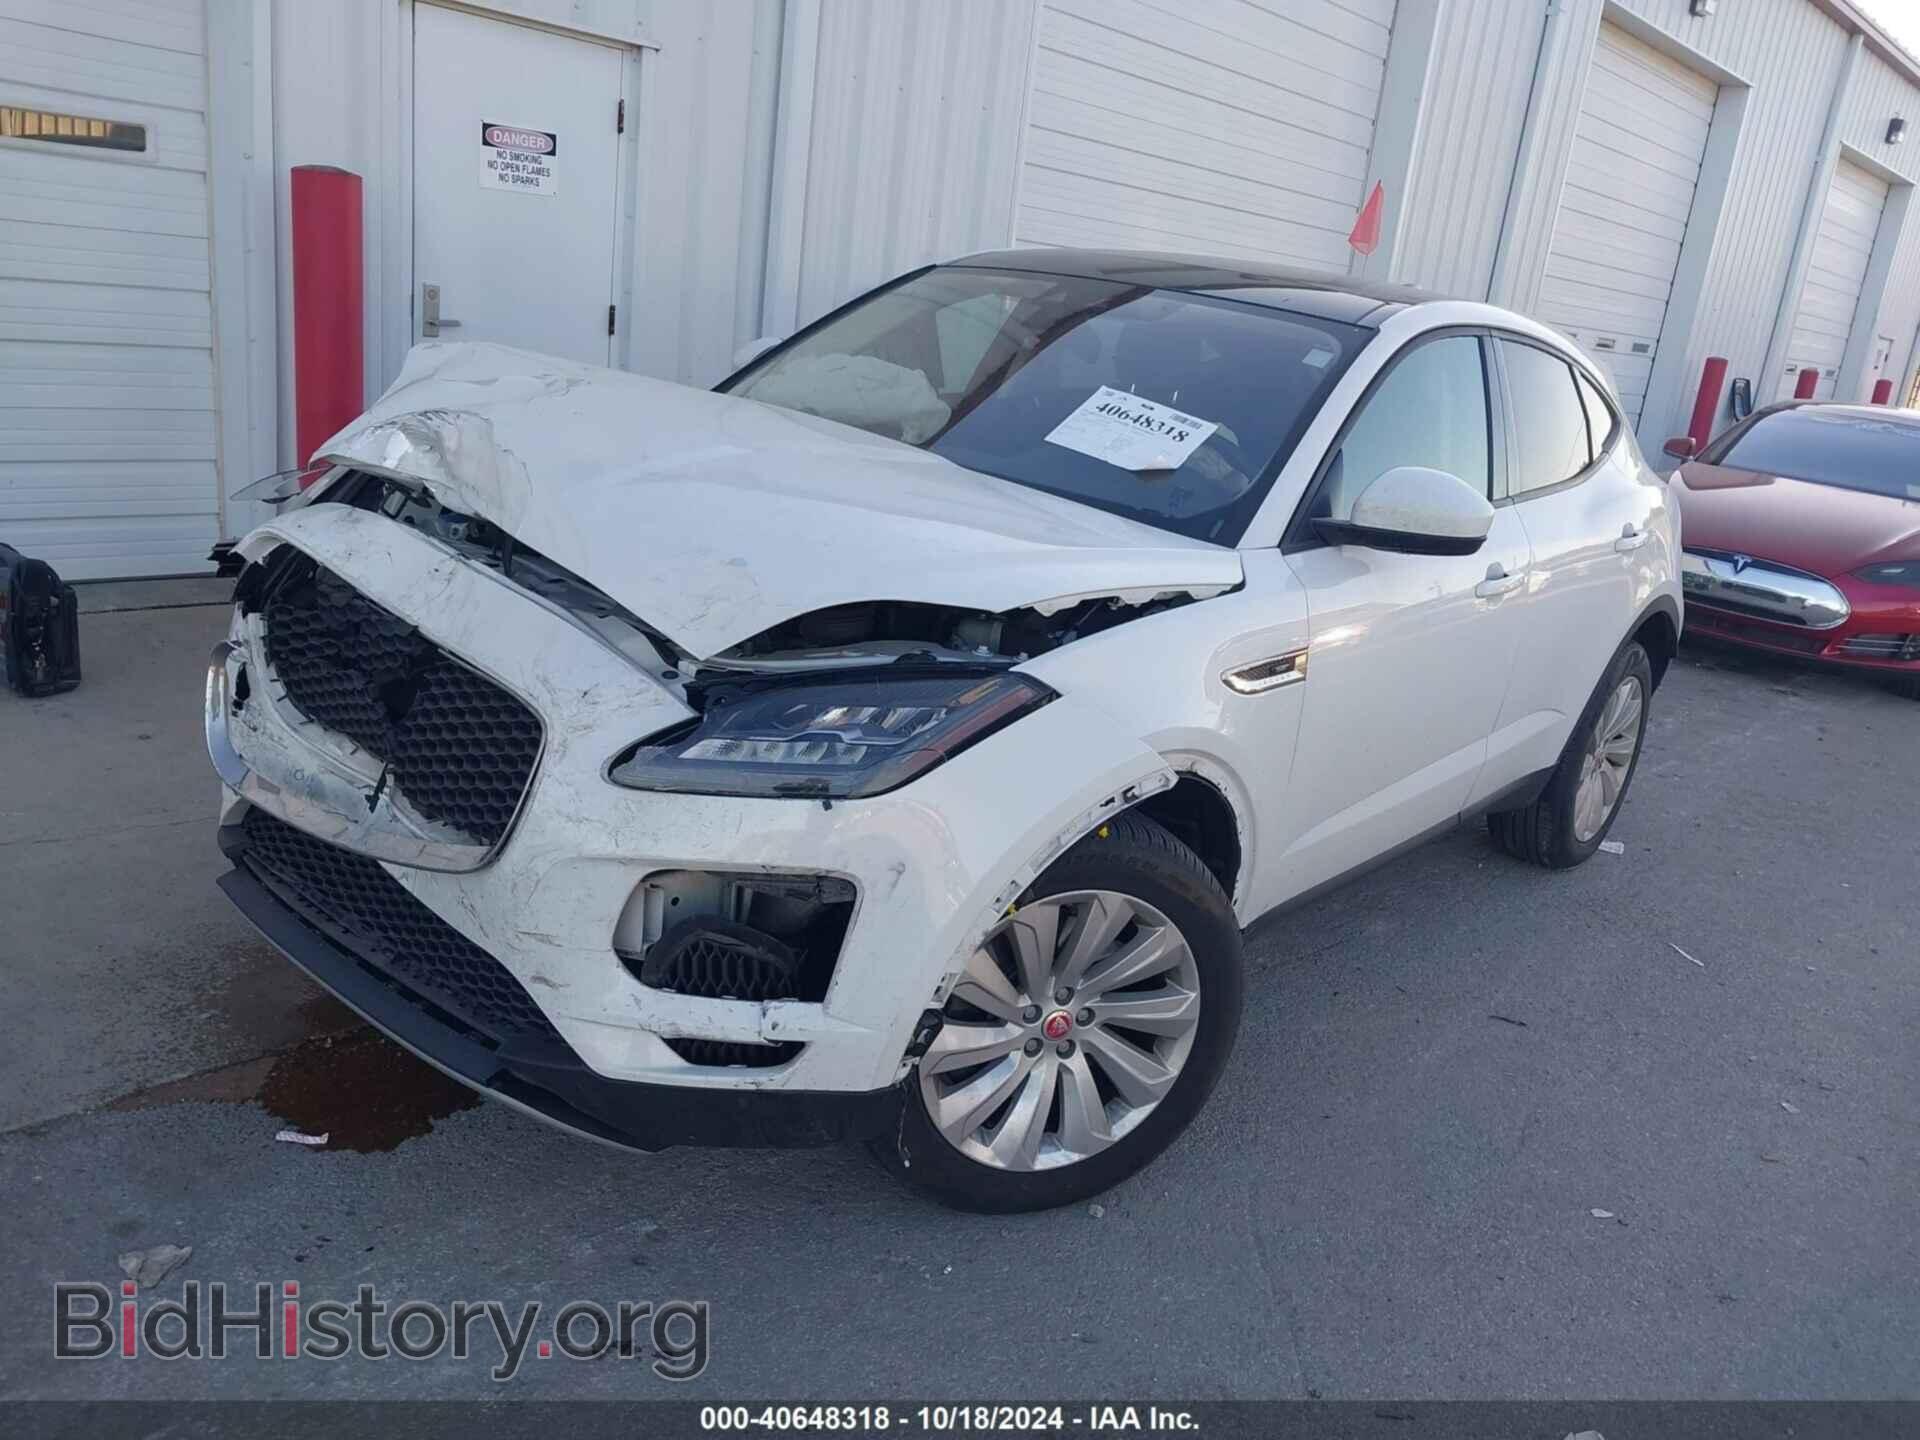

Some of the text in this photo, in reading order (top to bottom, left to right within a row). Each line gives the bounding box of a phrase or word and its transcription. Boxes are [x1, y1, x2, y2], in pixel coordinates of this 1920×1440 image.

[493, 130, 545, 149] DANGER
[496, 149, 542, 165] NO SMOKING
[487, 160, 551, 178] NO OPEN FLAMES
[498, 172, 540, 187] NO SPARKS
[1096, 402, 1190, 443] 40648318
